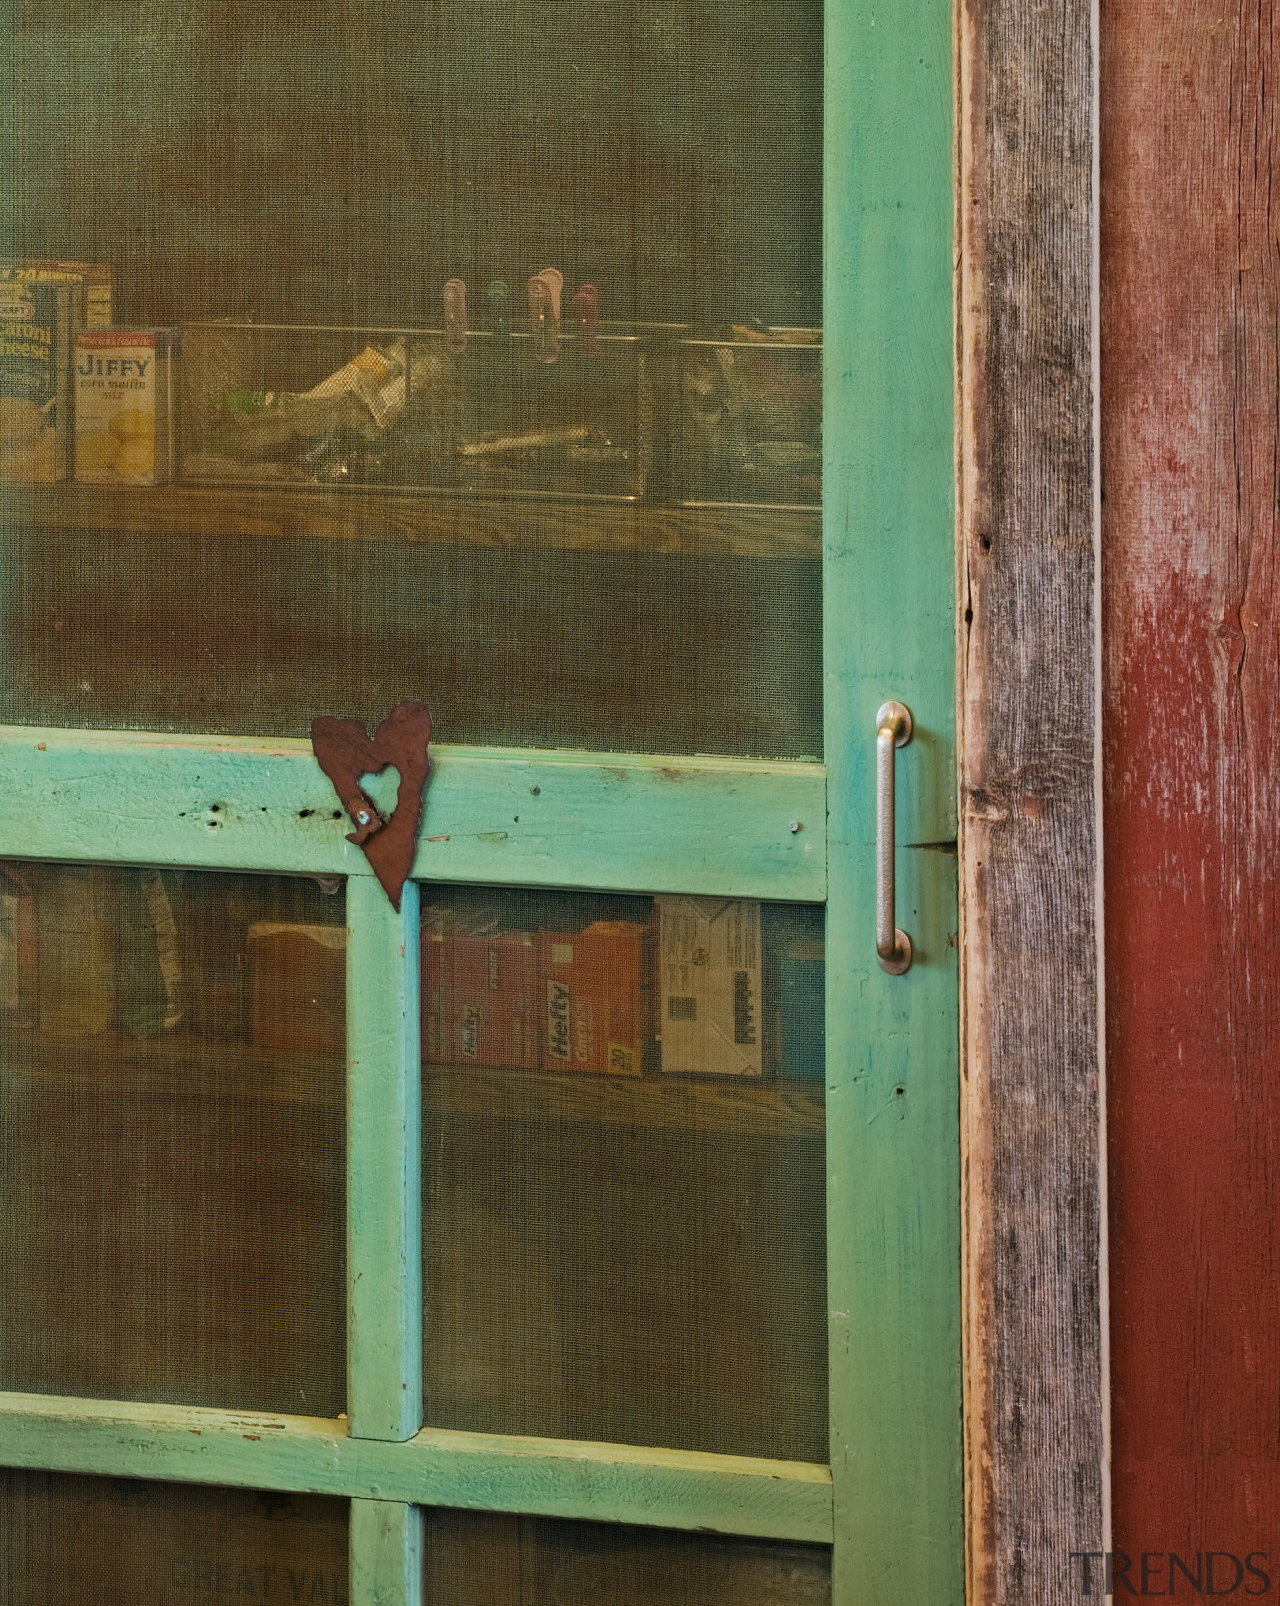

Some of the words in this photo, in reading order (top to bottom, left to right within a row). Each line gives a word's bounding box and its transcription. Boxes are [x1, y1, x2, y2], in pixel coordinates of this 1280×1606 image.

[78, 354, 149, 376] JIFFY
[549, 984, 570, 1057] Hefty
[611, 1049, 626, 1070] 20
